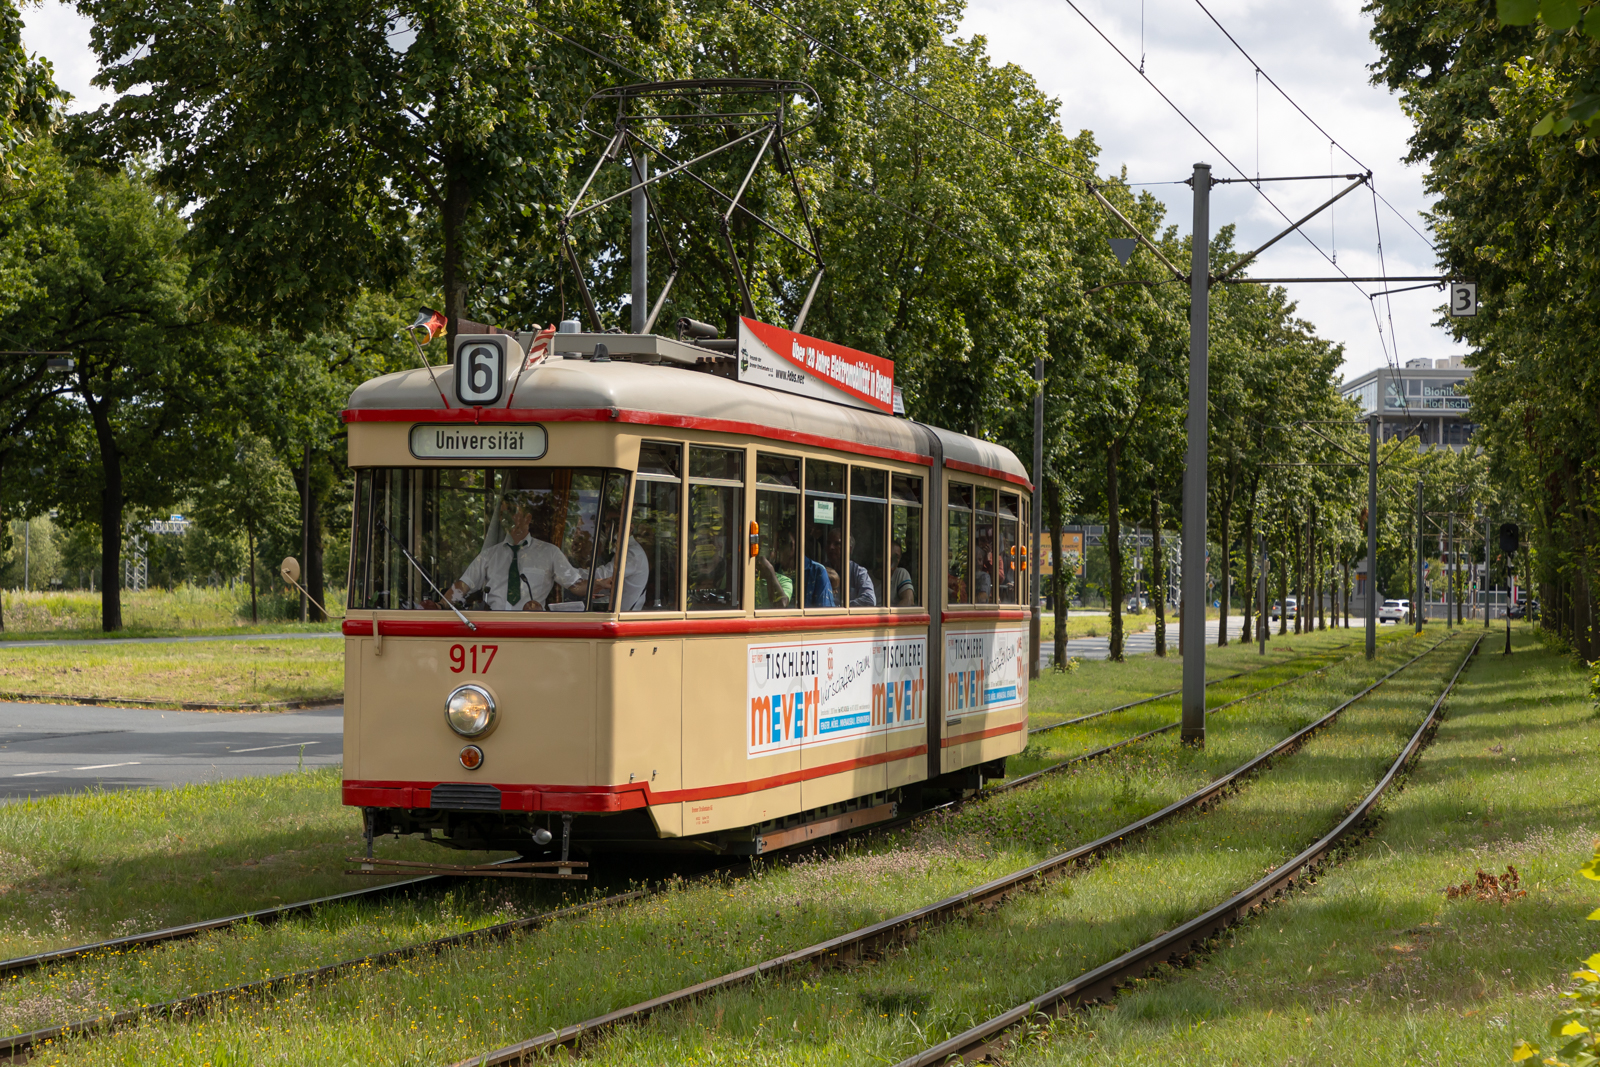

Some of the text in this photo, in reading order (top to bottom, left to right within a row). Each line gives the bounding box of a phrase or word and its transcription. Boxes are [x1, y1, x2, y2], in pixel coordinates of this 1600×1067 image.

[1456, 288, 1471, 311] 3
[468, 347, 493, 394] 6
[815, 350, 830, 376] Jahre
[436, 430, 524, 450] Universität
[449, 644, 498, 674] 917
[883, 643, 924, 669] TISCHLEREI
[955, 638, 984, 660] TISCHLEREI
[766, 650, 819, 680] TISCHLEREI
